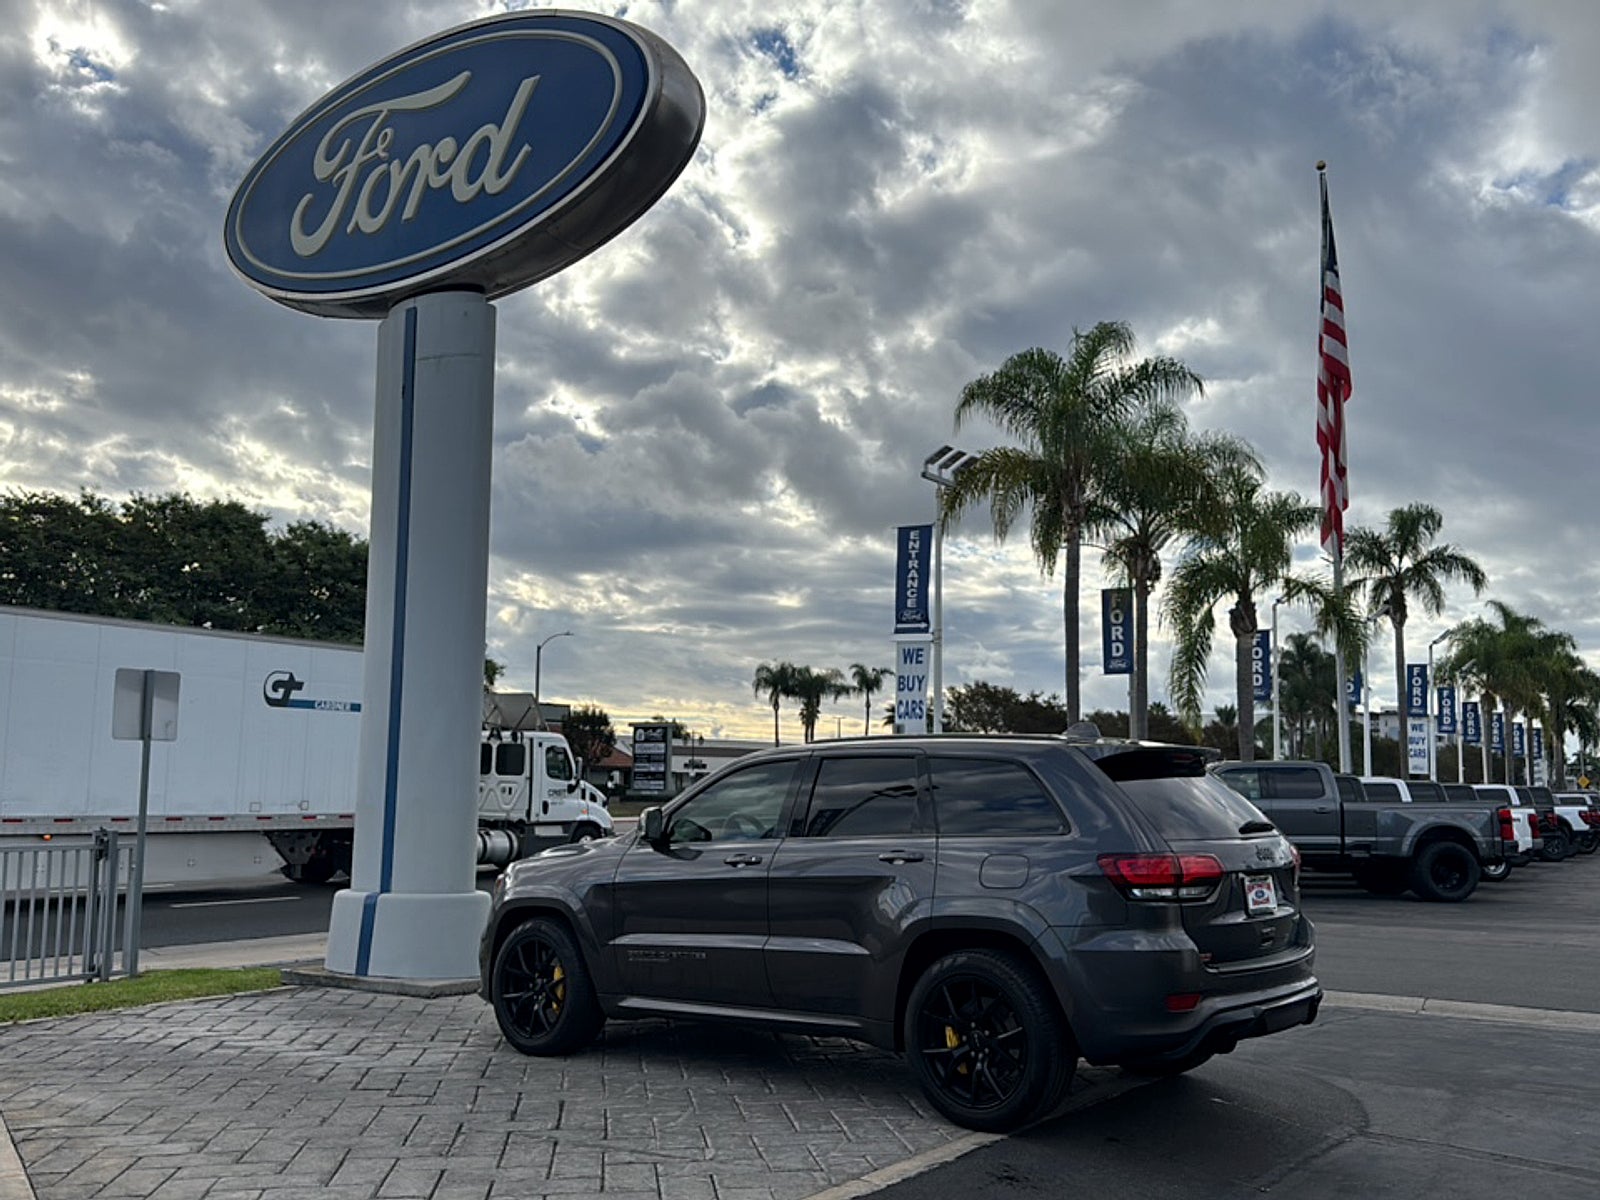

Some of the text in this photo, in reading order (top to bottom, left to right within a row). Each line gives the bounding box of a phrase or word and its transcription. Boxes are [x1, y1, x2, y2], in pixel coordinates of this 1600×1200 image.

[289, 70, 541, 257] Ford
[906, 530, 920, 608] ENTRANCE
[1110, 593, 1125, 657] FORD
[902, 647, 924, 665] WE
[898, 676, 925, 692] BUY
[1411, 666, 1422, 707] FORD
[897, 701, 924, 720] CARS
[1442, 690, 1452, 725] FORD
[1466, 703, 1475, 735] FORD
